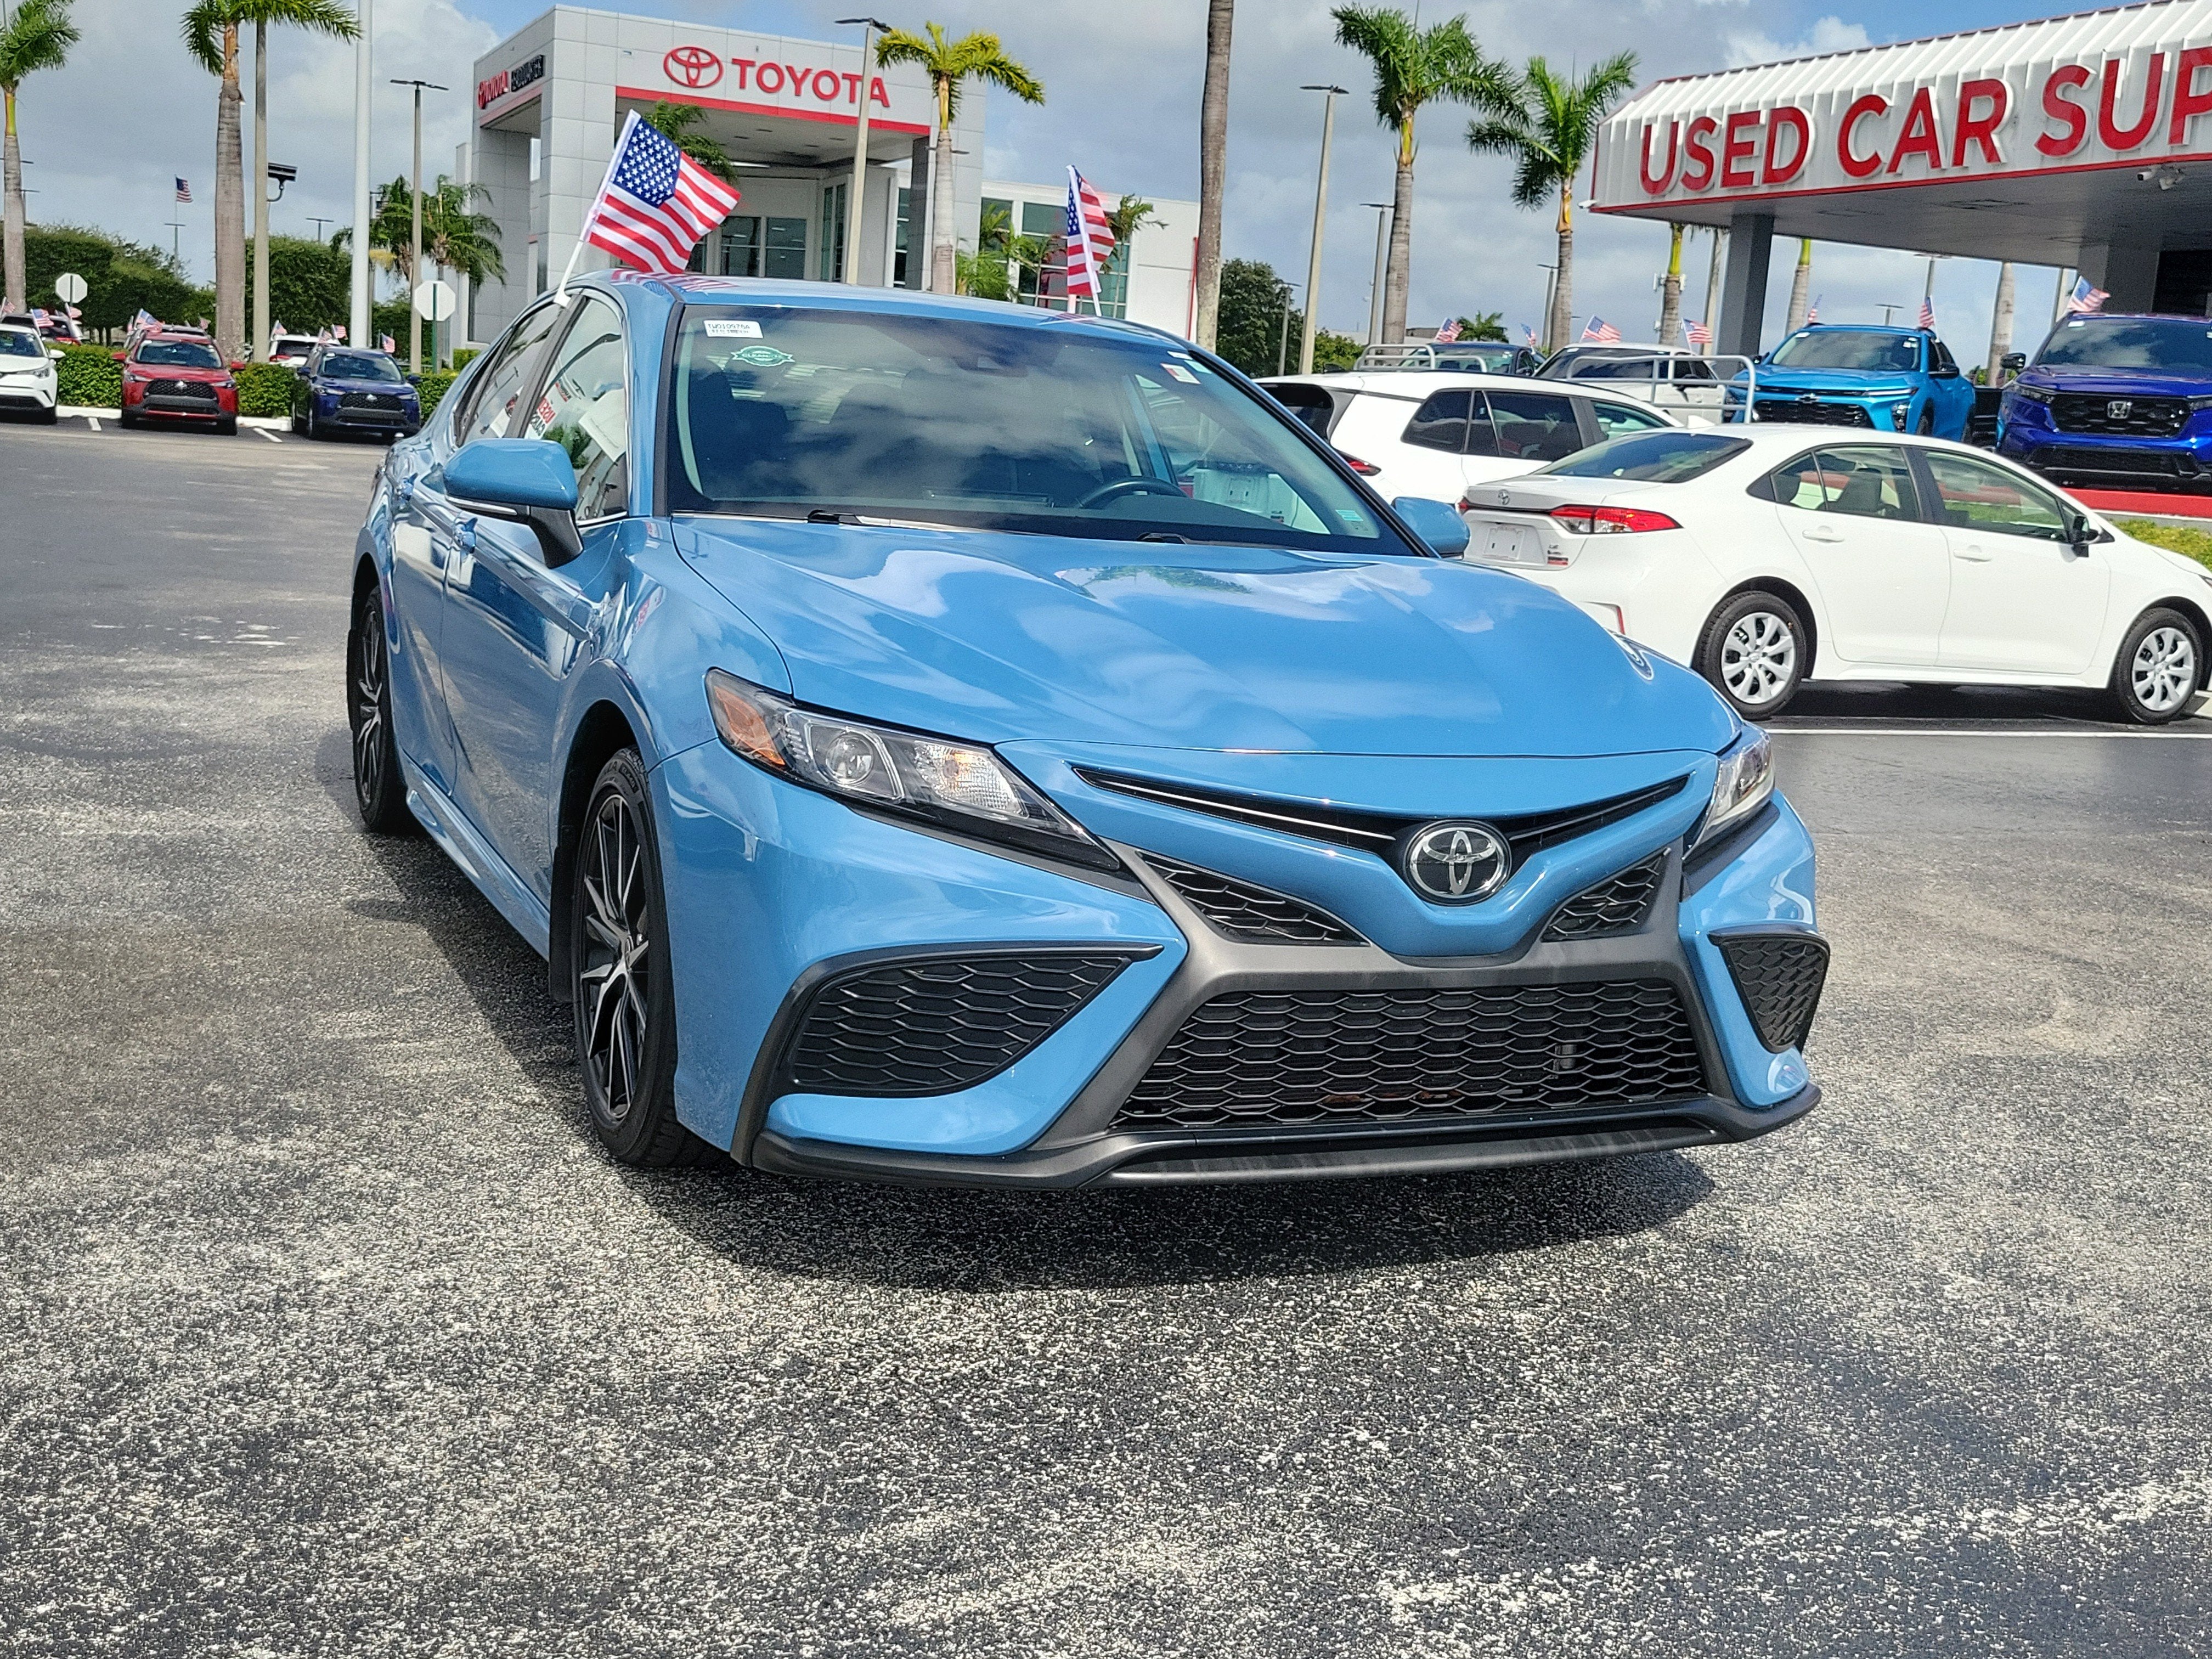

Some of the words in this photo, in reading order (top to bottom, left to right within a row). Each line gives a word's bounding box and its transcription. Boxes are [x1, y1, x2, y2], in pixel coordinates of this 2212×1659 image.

[732, 58, 890, 108] TOYOTA
[1639, 106, 1810, 195] USED
[1838, 78, 2008, 178] CAR
[2033, 47, 2212, 156] SUP
